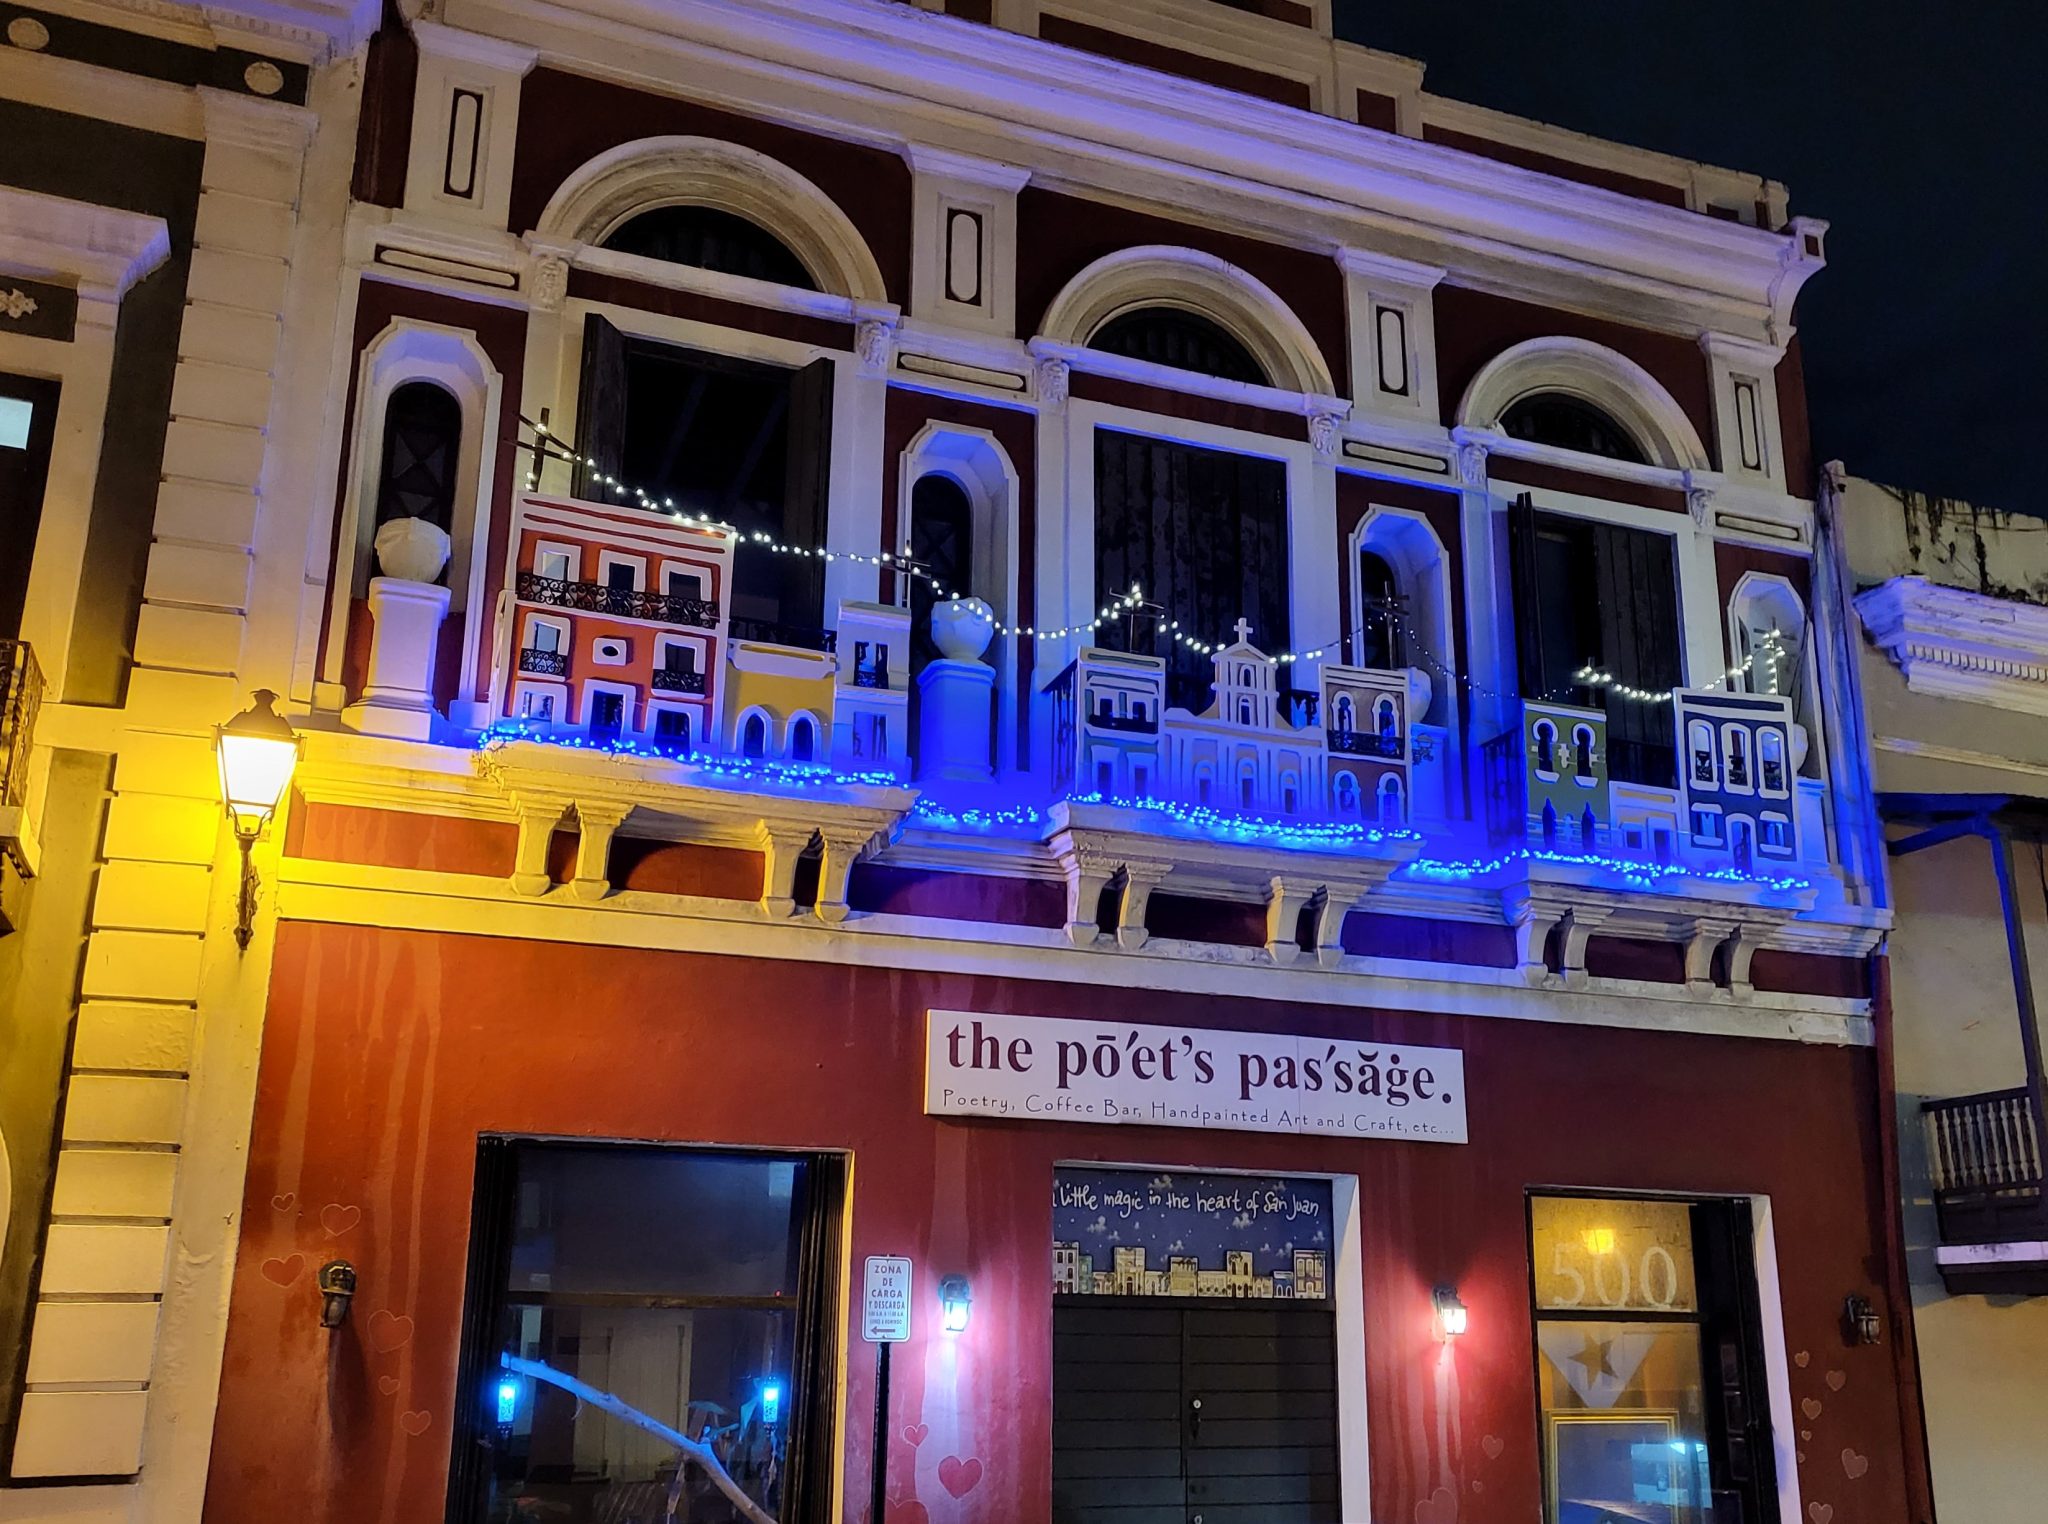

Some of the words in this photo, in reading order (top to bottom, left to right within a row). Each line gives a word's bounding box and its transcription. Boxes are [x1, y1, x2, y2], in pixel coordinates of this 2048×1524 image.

[945, 1021, 1033, 1073] the
[943, 1088, 1017, 1114] Poetry,
[1025, 1093, 1095, 1114] Coffee
[1103, 1098, 1143, 1119] Bar,
[1151, 1101, 1269, 1126] Handpainted
[1277, 1109, 1310, 1128] Art
[1316, 1111, 1346, 1130] and
[1353, 1113, 1409, 1134] Craft,
[1103, 1190, 1144, 1219] magic
[1148, 1189, 1161, 1206] in
[1165, 1191, 1191, 1210] the
[1196, 1188, 1242, 1213] heart
[1245, 1190, 1260, 1219] of
[1263, 1190, 1288, 1214] San
[1285, 1193, 1319, 1221] Juan
[874, 1265, 902, 1274] ZONA
[1552, 1243, 1677, 1308] 500
[882, 1278, 893, 1287] DE
[871, 1289, 903, 1298] CARGA
[868, 1301, 873, 1309] Y
[874, 1301, 906, 1309] DESCARGA
